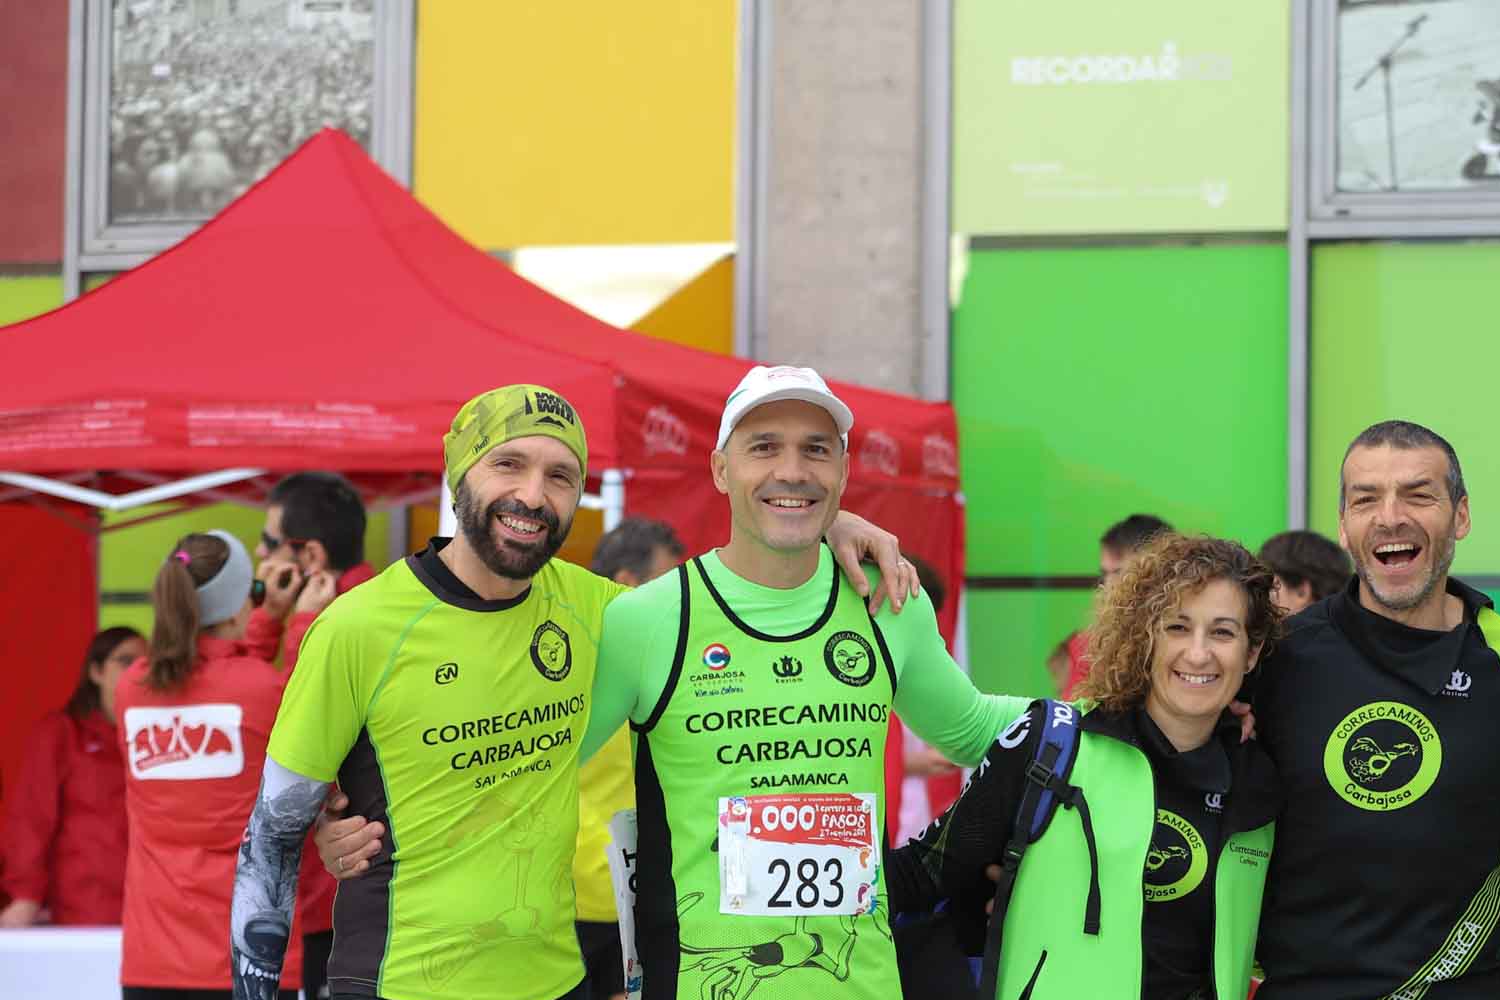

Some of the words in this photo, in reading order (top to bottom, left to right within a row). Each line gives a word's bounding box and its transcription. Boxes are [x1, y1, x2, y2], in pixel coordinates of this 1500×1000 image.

[423, 694, 584, 745] CORRECAMINOS
[686, 703, 888, 734] CORRECAMINOS
[1337, 705, 1435, 742] CORRECAMINOS
[451, 728, 572, 770] CARBAJOSA
[717, 738, 872, 765] CARBAJOSA
[750, 773, 849, 789] SALAMANCA
[1344, 782, 1413, 810] Carbajosa
[767, 858, 844, 908] 283
